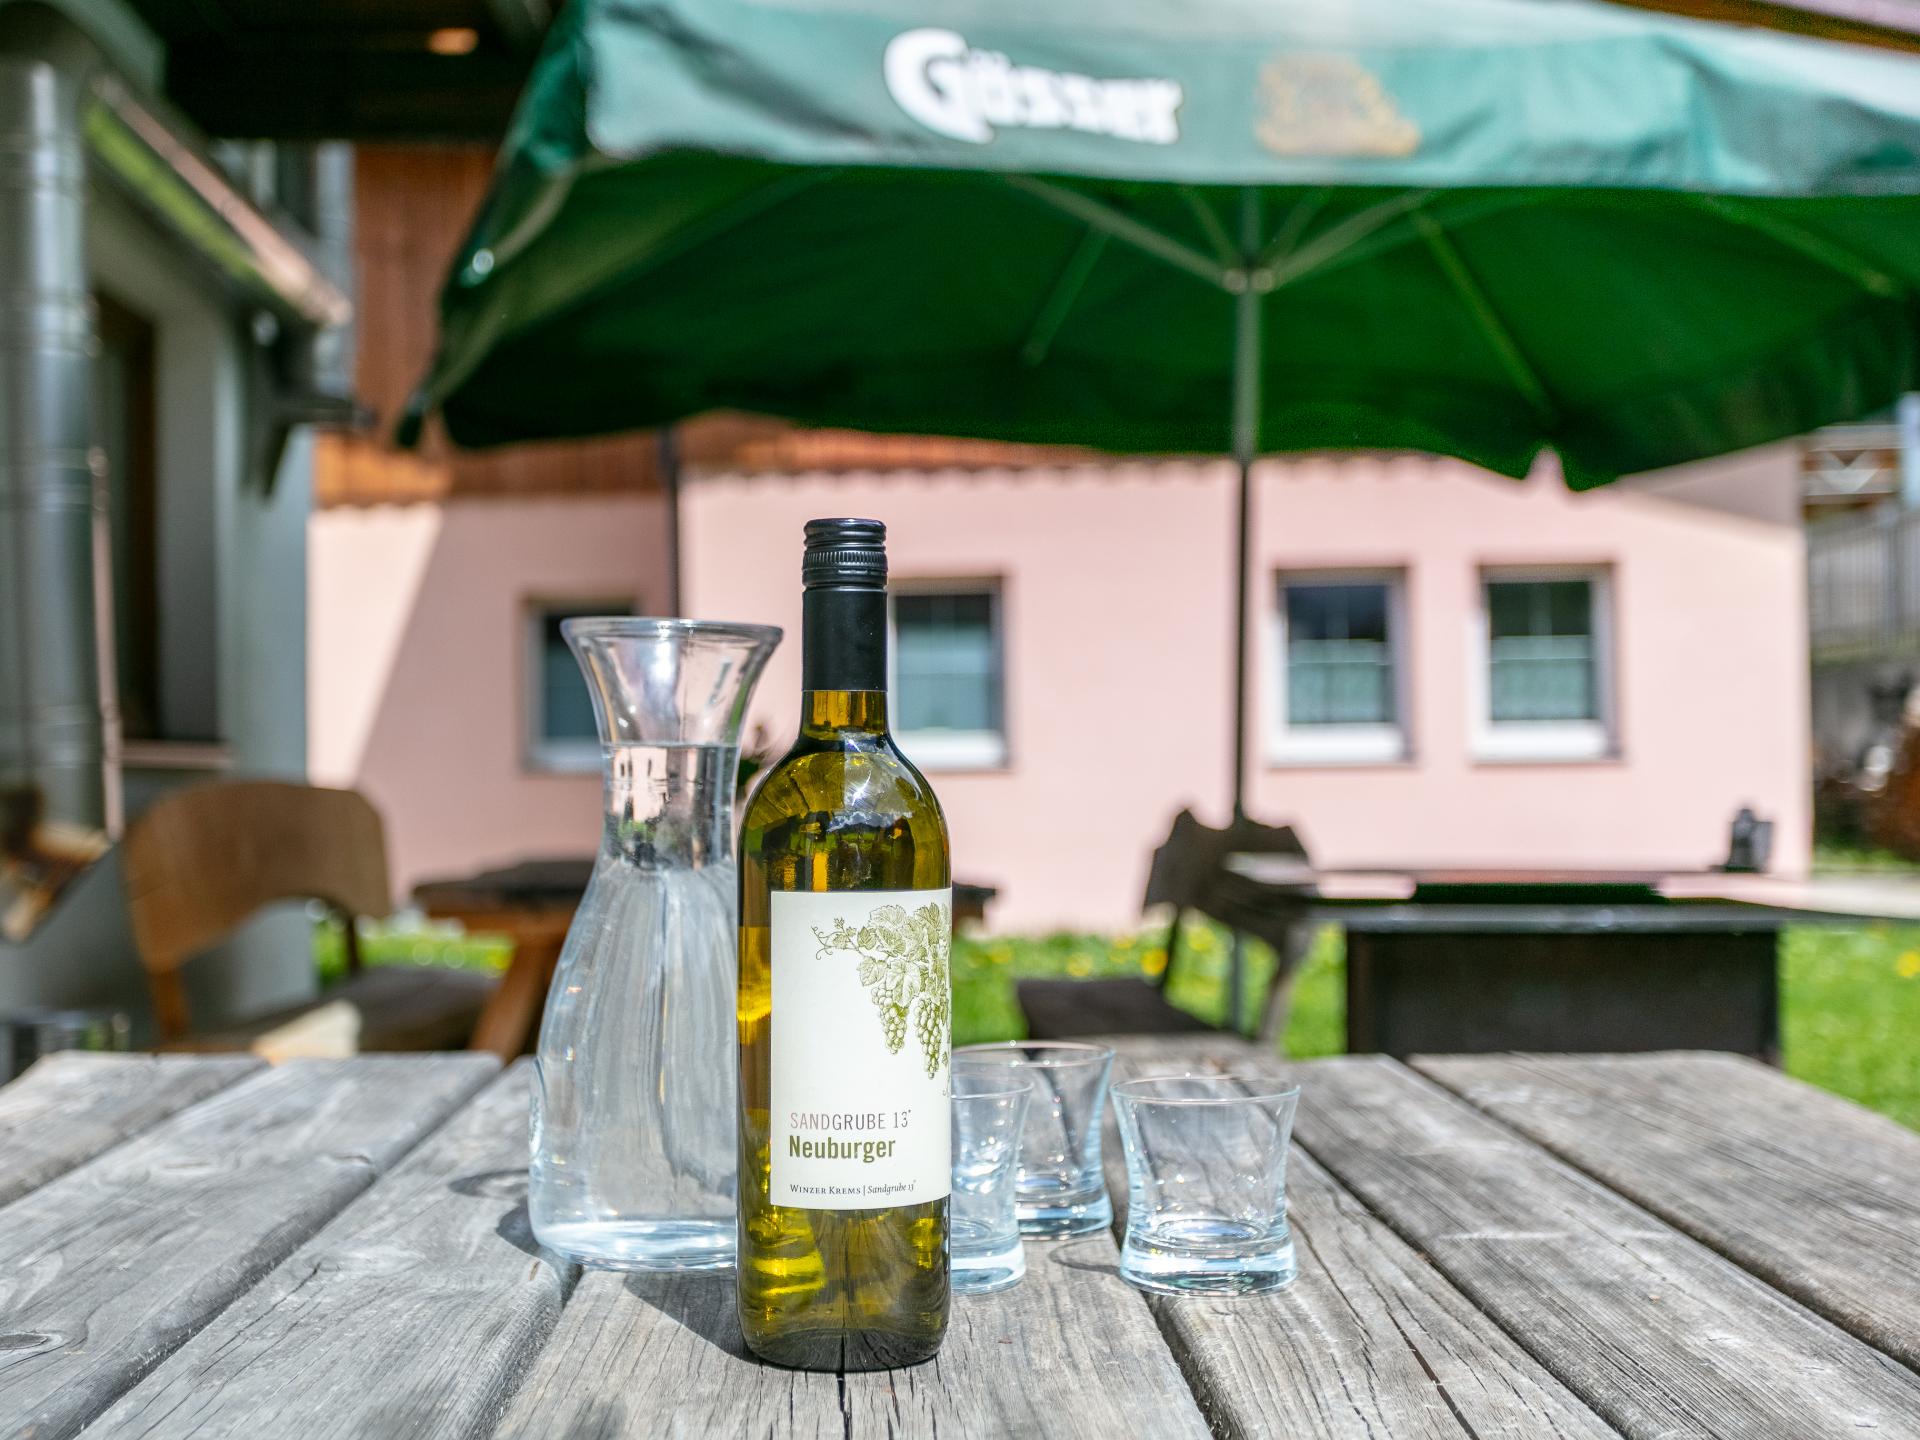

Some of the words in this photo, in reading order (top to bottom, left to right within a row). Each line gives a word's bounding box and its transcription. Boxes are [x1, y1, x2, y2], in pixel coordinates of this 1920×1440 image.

[790, 1112, 886, 1131] SANDGRUBE
[789, 1135, 896, 1163] Neuburger
[790, 1184, 827, 1195] WINZER
[829, 1185, 861, 1195] KREMS
[867, 1182, 907, 1195] Sandgrube
